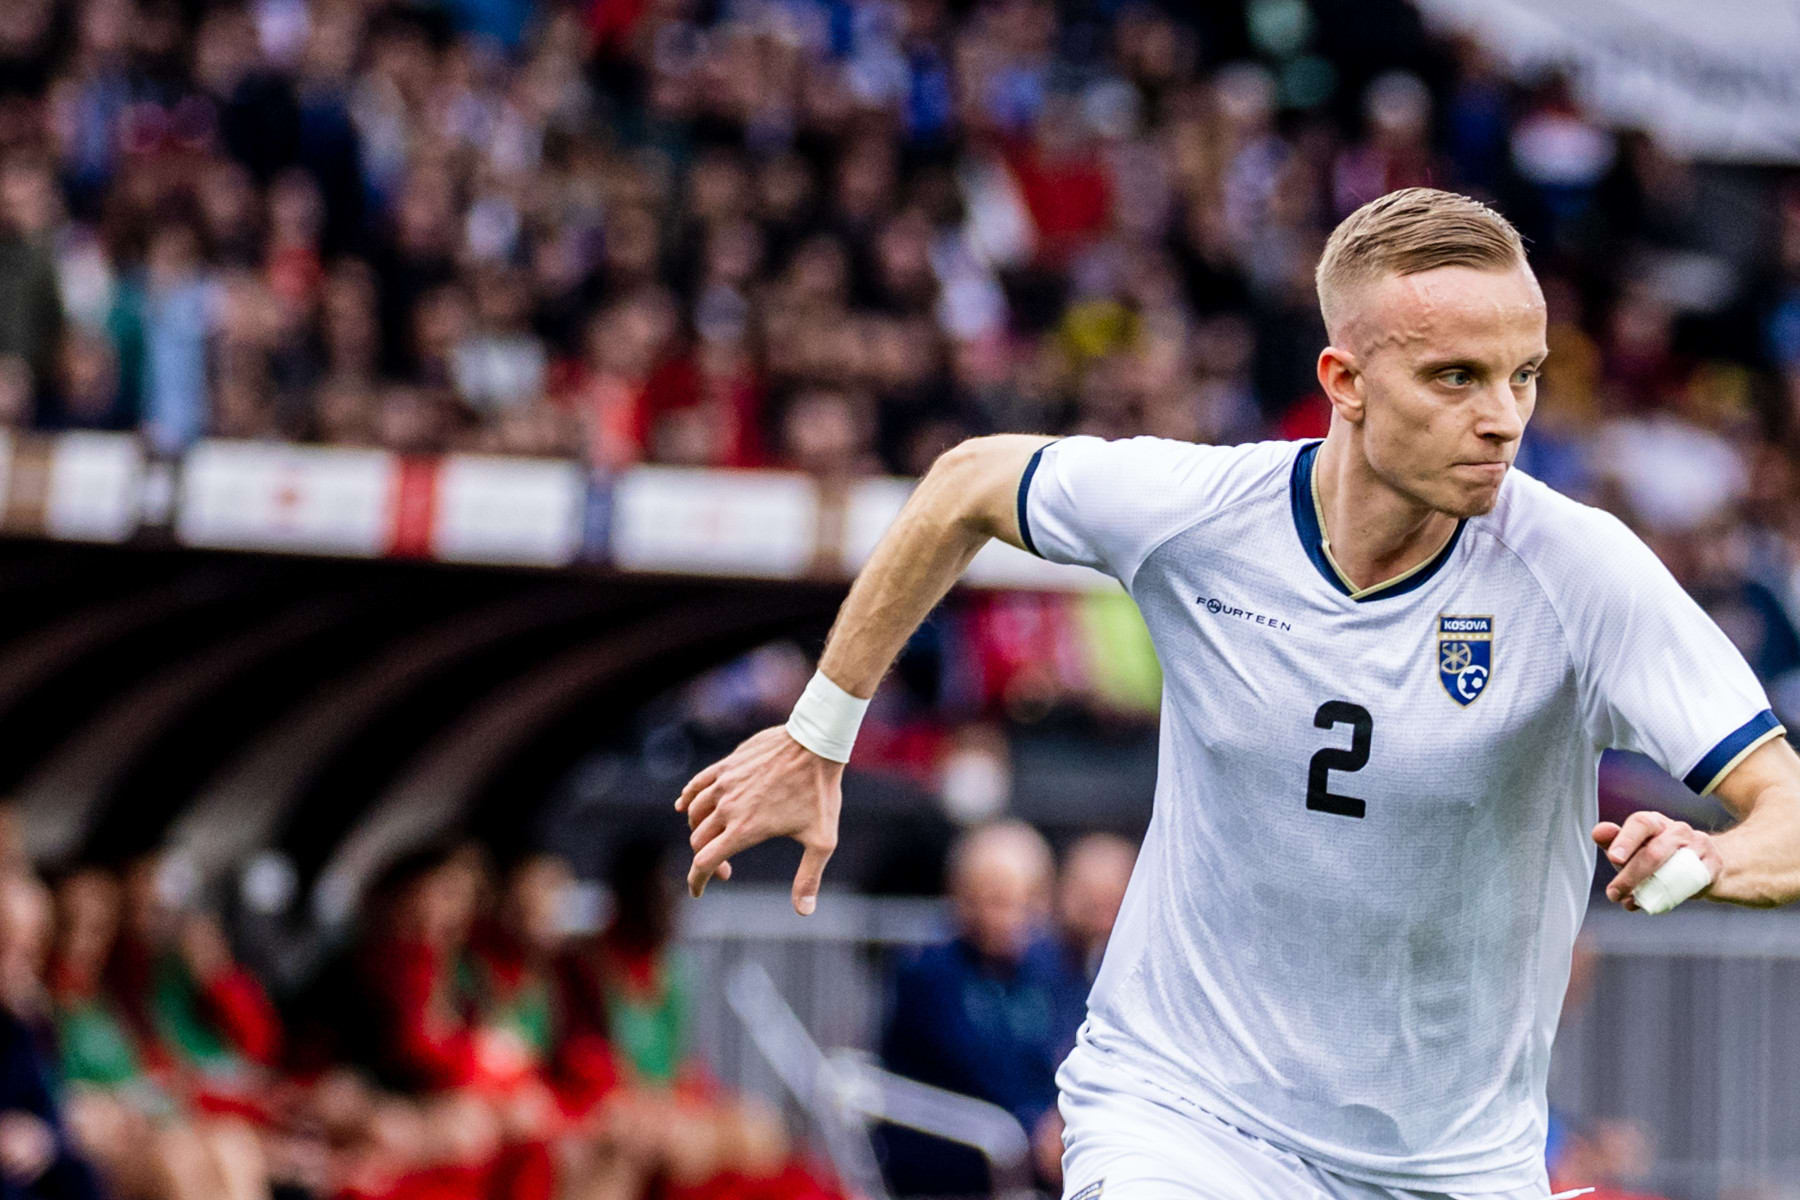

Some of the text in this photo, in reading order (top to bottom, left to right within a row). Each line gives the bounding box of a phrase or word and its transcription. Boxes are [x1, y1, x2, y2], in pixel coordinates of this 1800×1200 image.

[1196, 597, 1291, 631] FOURTEEN
[1443, 619, 1488, 631] KOSOVA
[1306, 700, 1373, 818] 2
